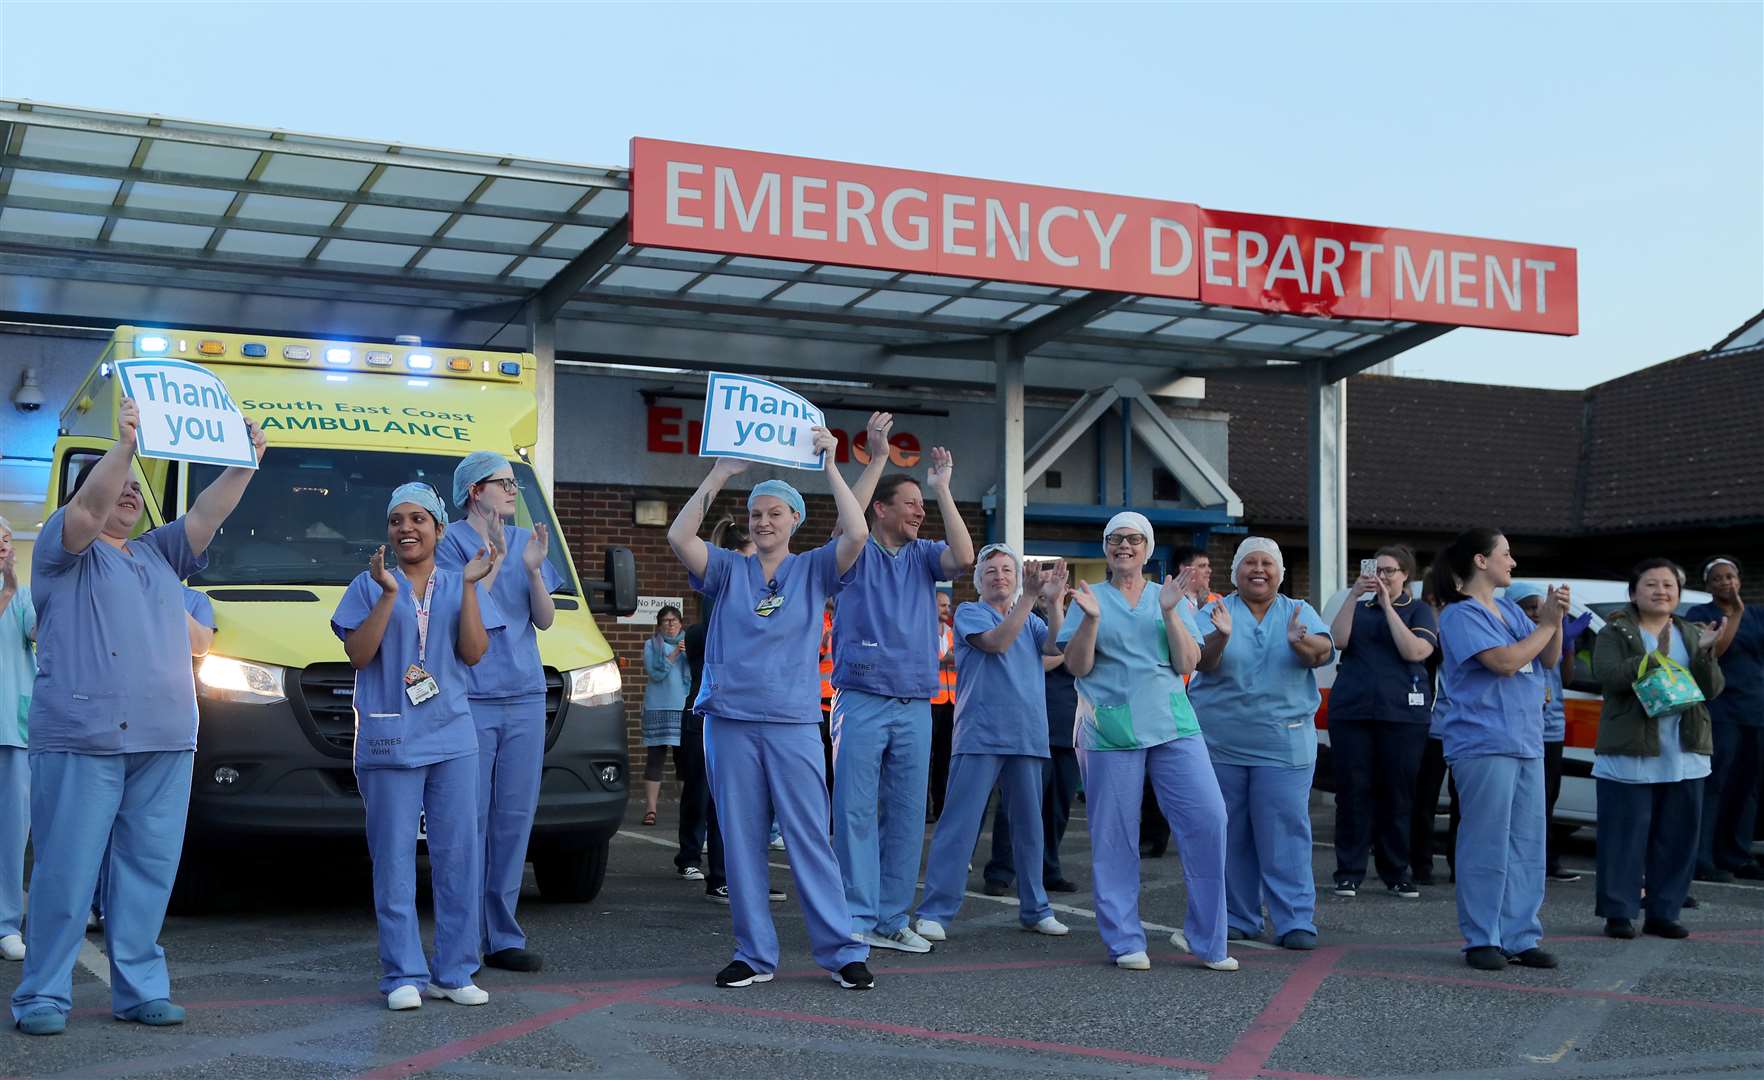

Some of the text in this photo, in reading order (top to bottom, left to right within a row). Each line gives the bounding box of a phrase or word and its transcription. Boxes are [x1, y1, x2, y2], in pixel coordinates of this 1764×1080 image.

[666, 160, 1556, 314] EMERGENCY DEPARTMENT
[134, 371, 236, 413] Thank
[719, 384, 817, 424] Thank
[242, 400, 476, 423] South East Coast
[164, 414, 225, 446] you
[260, 416, 471, 442] AMBULANCE
[733, 419, 797, 447] you
[651, 600, 681, 609] Parking
